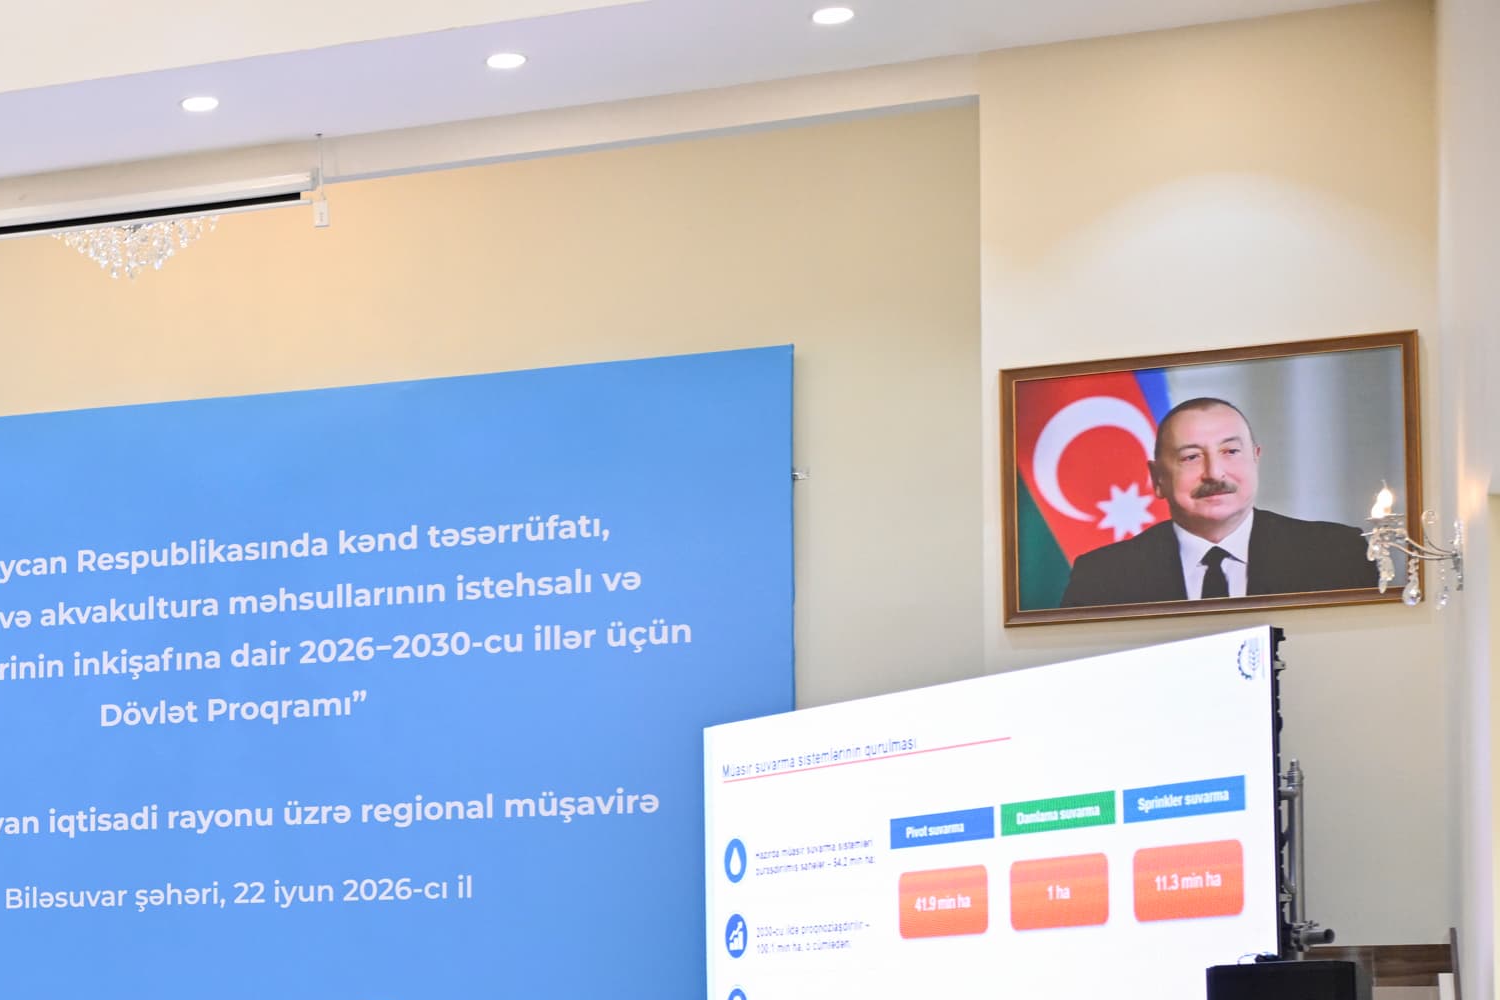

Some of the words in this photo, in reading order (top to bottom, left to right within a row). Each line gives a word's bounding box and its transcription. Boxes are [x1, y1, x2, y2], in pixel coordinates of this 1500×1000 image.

[77, 532, 328, 575] Respublikasında
[338, 524, 418, 555] kənd
[427, 514, 610, 549] təsərrüfatı,
[40, 595, 219, 627] akvakultura
[229, 582, 446, 615] məhsullarının
[456, 568, 592, 601] istehsalı
[601, 571, 642, 592] və
[73, 646, 221, 681] inkişafına
[230, 639, 291, 668] dair
[299, 631, 523, 664] 2026–2030-cu
[534, 624, 597, 651] illər
[607, 618, 692, 654] üçün
[100, 699, 199, 727] Dövlət
[207, 689, 367, 725] Proqramı”
[49, 803, 158, 839] iqtisadi
[167, 807, 273, 835] rayonu
[283, 800, 352, 826] üzrə
[361, 793, 494, 828] regional
[504, 787, 660, 824] müşavirə
[1137, 794, 1183, 813] Sprinkler
[1184, 790, 1229, 806] suvarma
[906, 826, 928, 839] Pivot
[5, 885, 128, 910] Biləsuvar
[135, 880, 226, 913] şəhəri,
[233, 881, 266, 904] 22
[274, 879, 334, 909] iyun
[342, 877, 448, 902] 2026-cı
[457, 874, 473, 899] il
[1047, 885, 1054, 900] 1
[1056, 884, 1071, 900] ha
[1155, 873, 1179, 892] 11.3
[1181, 872, 1203, 890] min
[1205, 871, 1222, 888] ha
[914, 896, 936, 912] 41.9
[937, 895, 956, 910] min
[957, 894, 971, 909] ha
